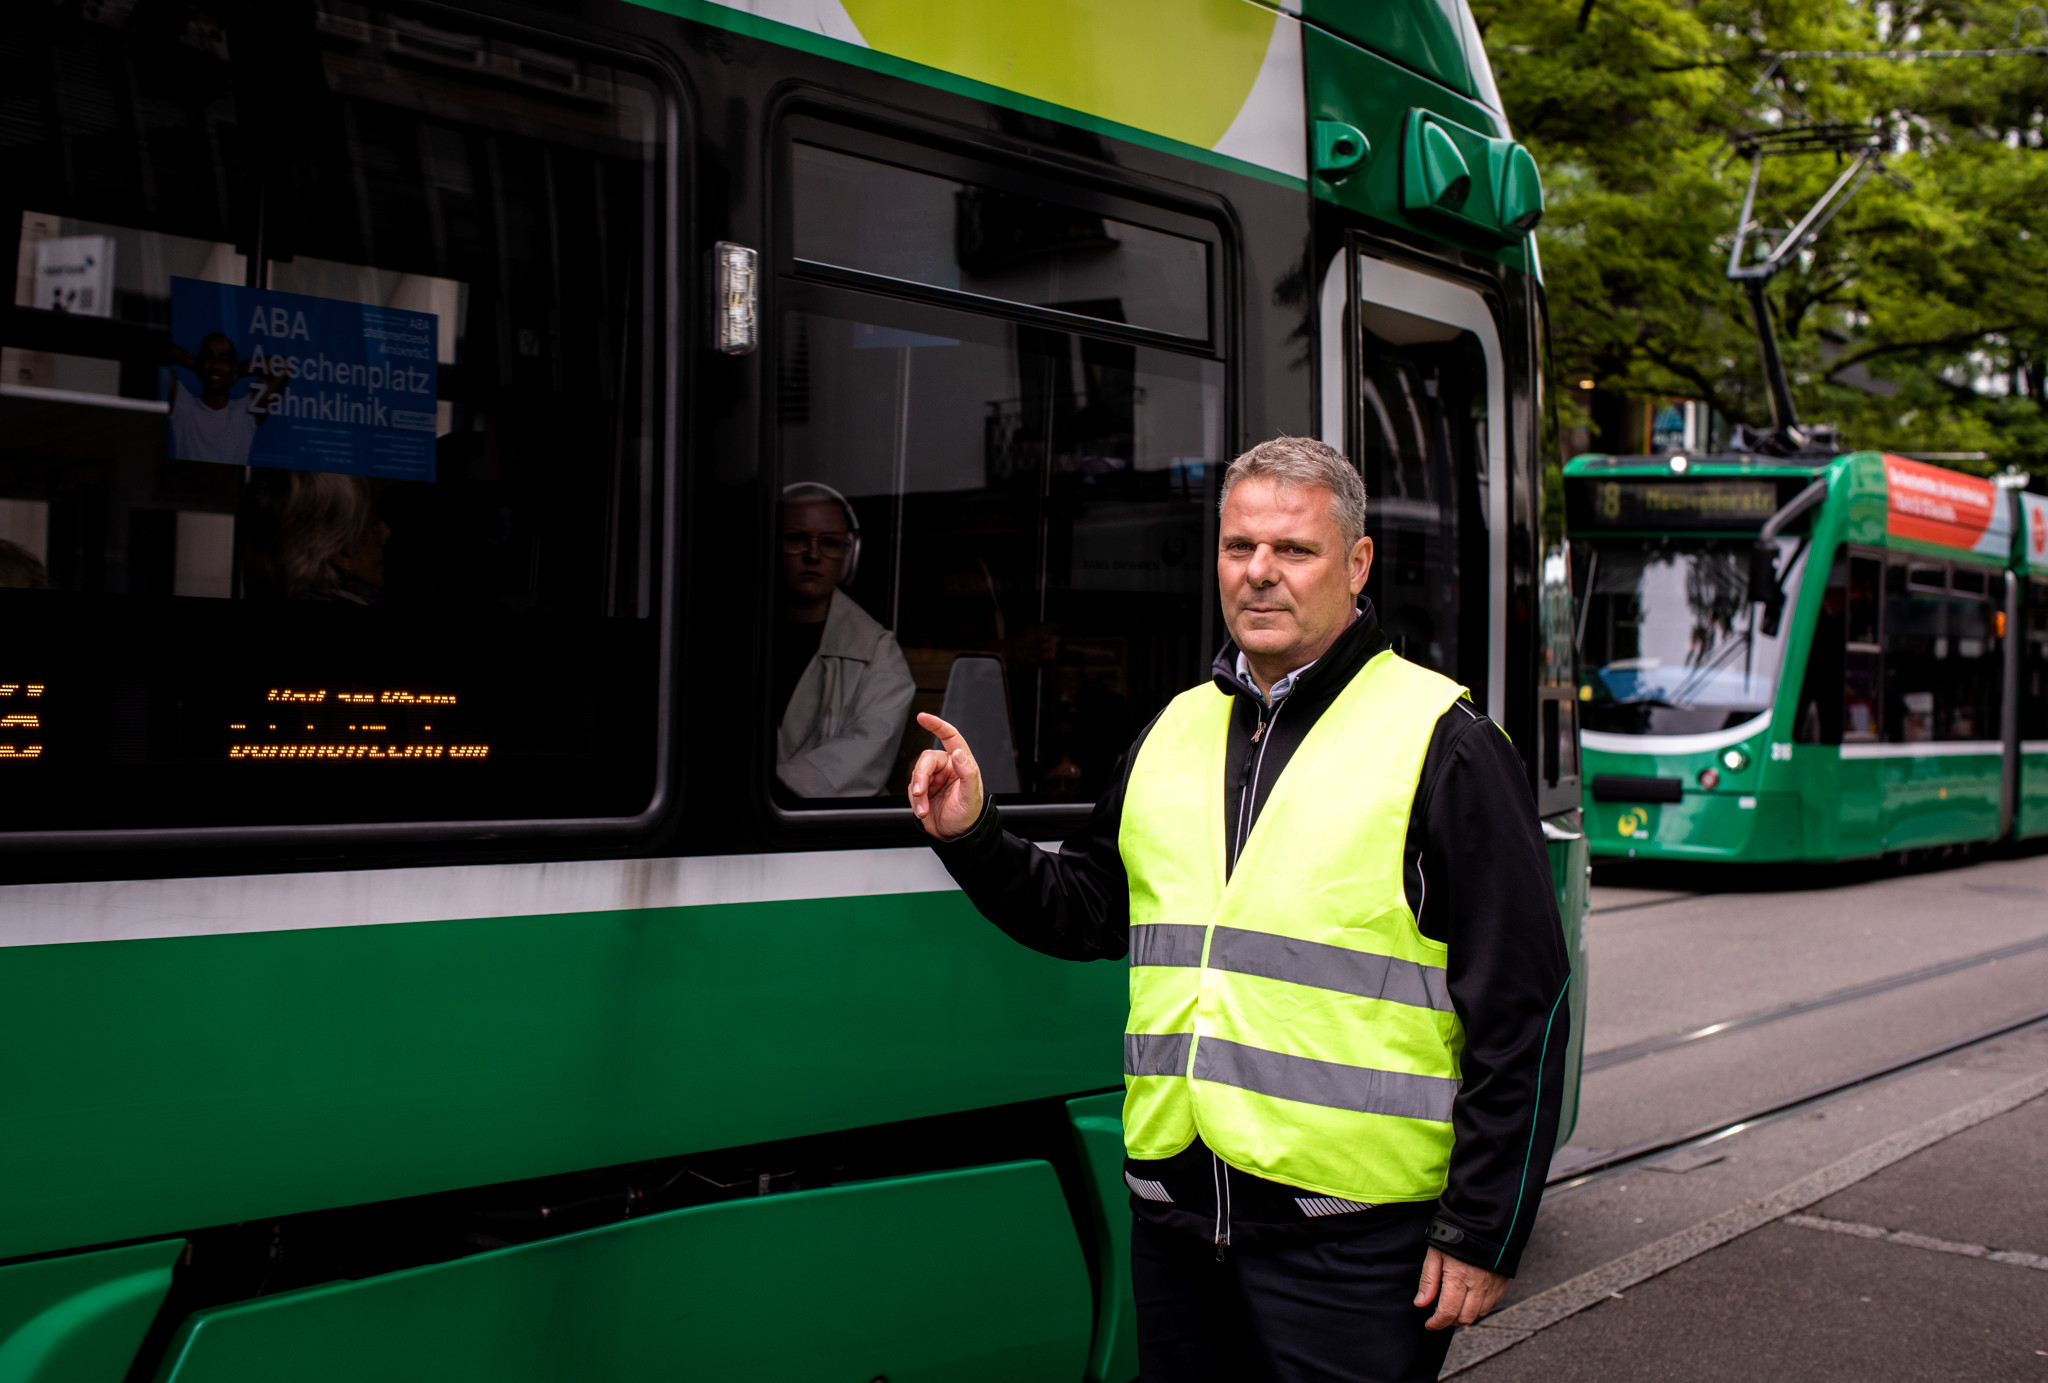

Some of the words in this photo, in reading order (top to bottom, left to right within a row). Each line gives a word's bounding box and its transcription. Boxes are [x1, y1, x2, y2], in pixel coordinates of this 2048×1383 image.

[248, 305, 311, 341] ABA
[248, 344, 430, 394] Aeschenplatz
[247, 382, 389, 428] Zahnklinik
[1603, 481, 1620, 517] 8
